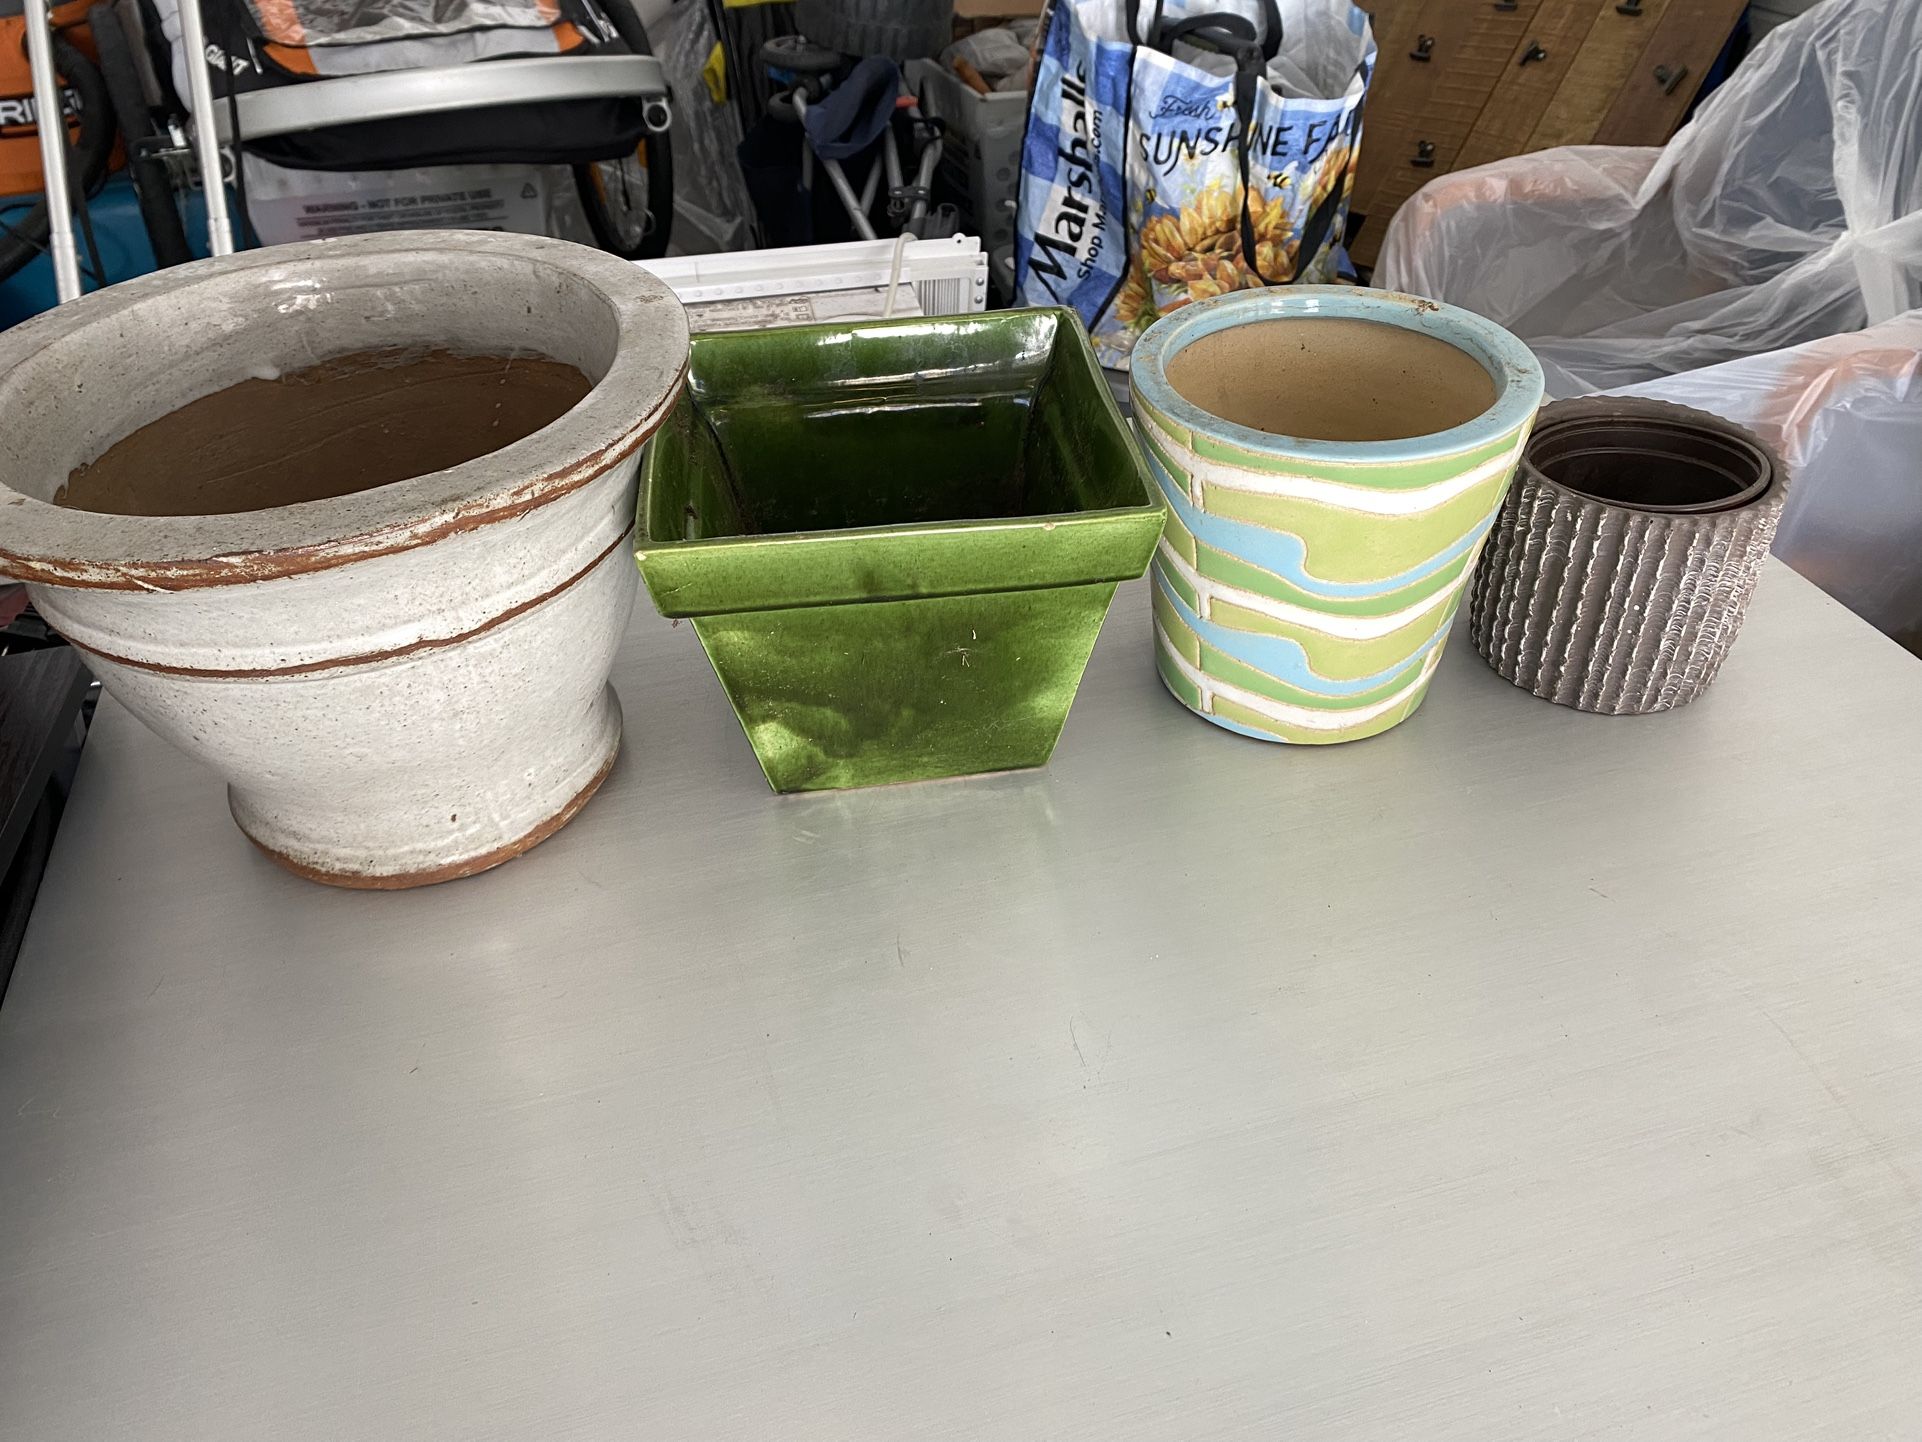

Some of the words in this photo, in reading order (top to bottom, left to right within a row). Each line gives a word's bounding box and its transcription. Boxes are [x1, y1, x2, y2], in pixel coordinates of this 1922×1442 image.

[1149, 94, 1216, 121] Fresh
[367, 198, 390, 210] NOT
[394, 196, 419, 208] FOR
